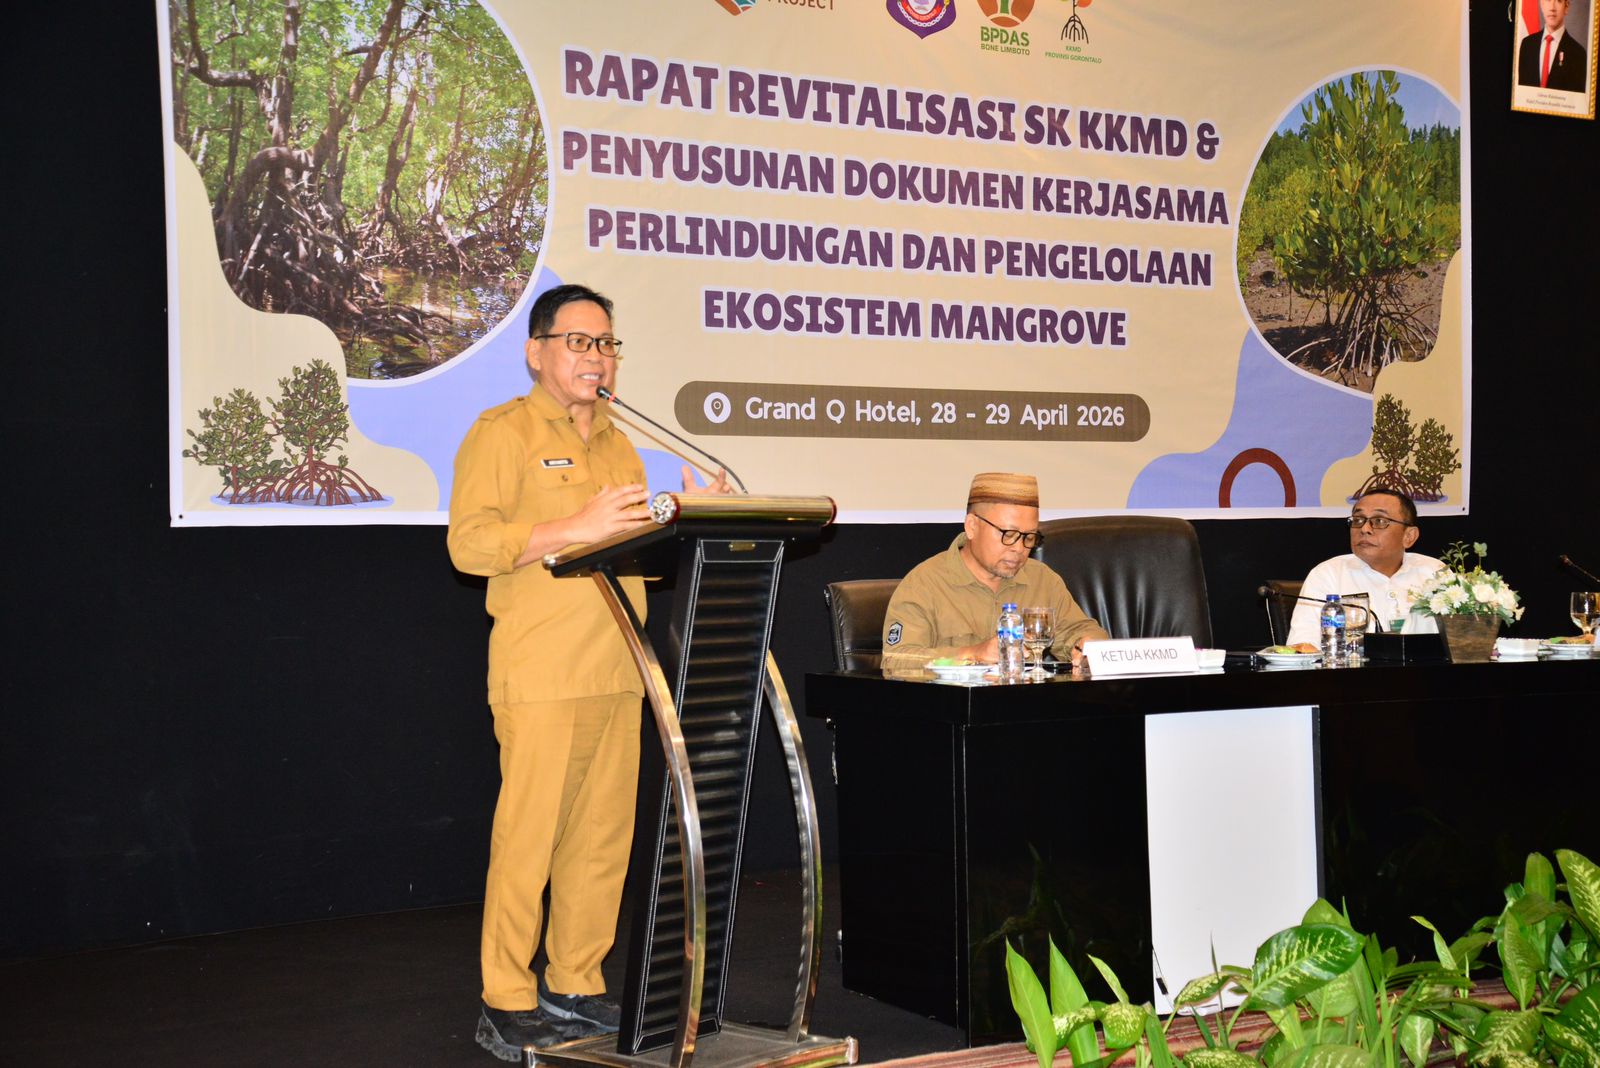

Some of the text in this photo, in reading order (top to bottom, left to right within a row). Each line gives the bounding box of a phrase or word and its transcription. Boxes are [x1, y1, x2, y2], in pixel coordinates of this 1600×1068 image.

[980, 26, 1030, 47] BPDAS
[980, 43, 1030, 56] BONE LIMBOTO
[1045, 51, 1102, 63] PROVINSI GORONTALO
[564, 49, 1220, 160] RAPAT REVITALISASI SK KKMD &
[562, 130, 1229, 225] PENYUSUNAN DOKUMEN KERJASAMA
[588, 208, 1212, 286] PERLINDUNGAN DAN PENGELOLAAN
[704, 290, 1126, 346] EKOSISTEM MANGROVE
[745, 396, 816, 420] Grand
[826, 399, 846, 424] Q
[855, 400, 921, 426] Hotel,
[931, 402, 957, 424] 28
[985, 403, 1010, 425] 29
[1020, 404, 1068, 431] April
[1076, 405, 1125, 427] 2026
[1101, 648, 1178, 661] KETUA KKMD
